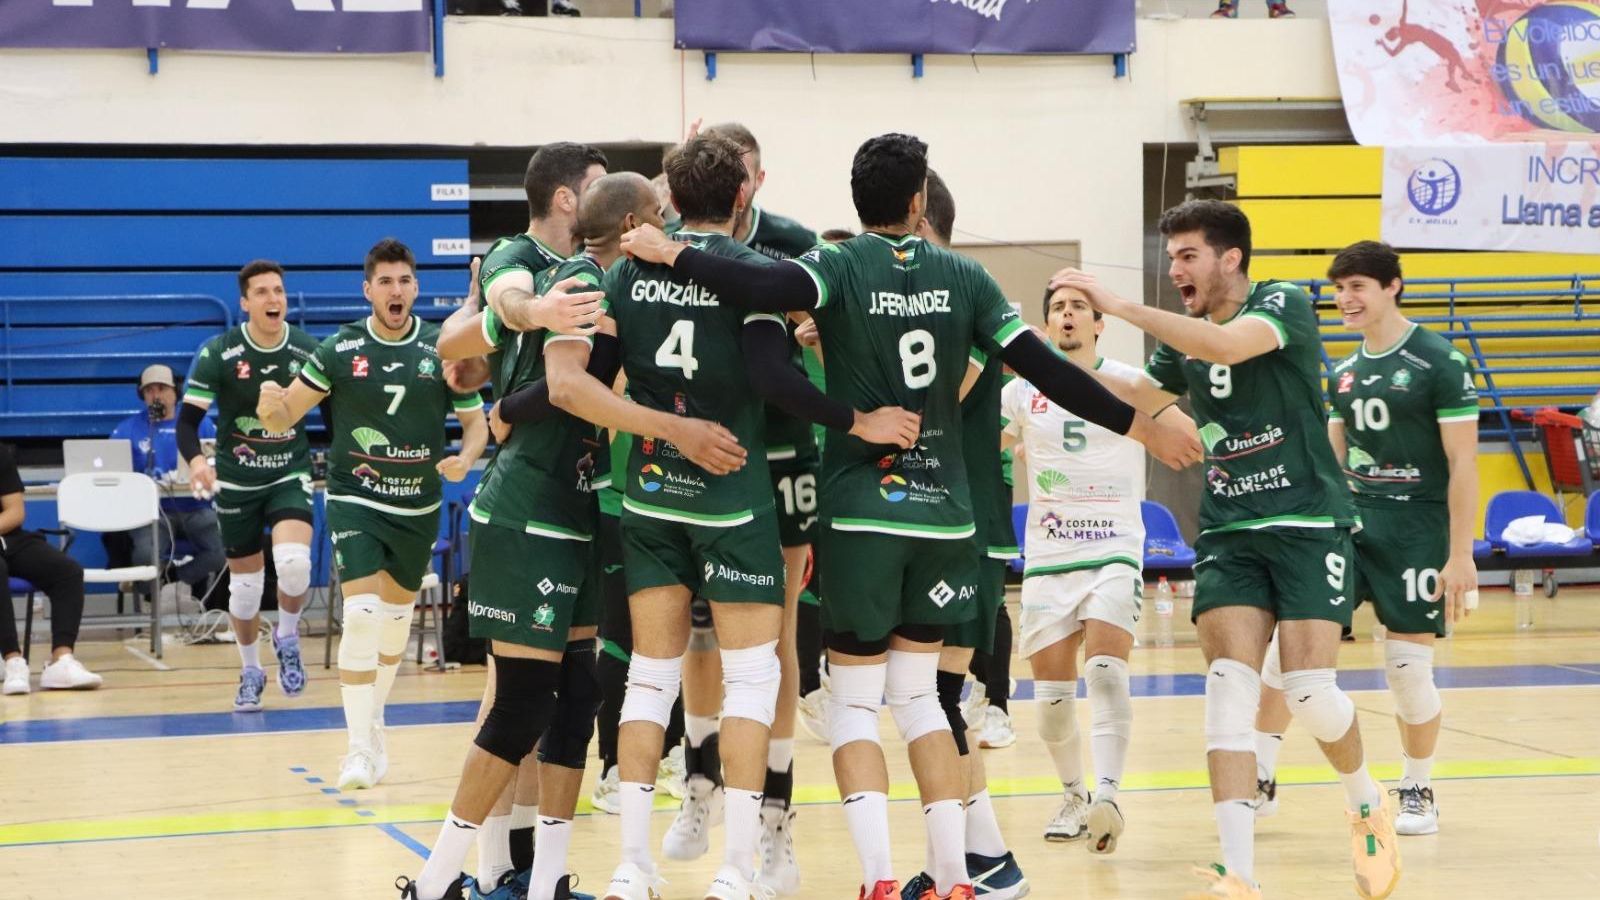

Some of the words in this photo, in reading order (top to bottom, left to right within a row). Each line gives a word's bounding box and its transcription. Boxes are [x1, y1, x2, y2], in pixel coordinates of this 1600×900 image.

[1484, 18, 1506, 43] El
[1490, 63, 1522, 81] es
[1528, 63, 1561, 81] un
[1528, 155, 1600, 185] INCR
[1502, 194, 1582, 227] Llama
[655, 319, 698, 380] 4
[898, 328, 937, 390] 8
[1209, 363, 1233, 399] 9
[383, 384, 406, 415] 7
[1350, 397, 1390, 432] 10
[386, 443, 431, 460] Unicaja
[1062, 420, 1088, 453] 5
[1225, 424, 1284, 452] Unicaja
[382, 477, 412, 486] COSTA
[412, 476, 424, 485] DE
[1269, 464, 1286, 479] DE
[372, 483, 422, 496] ALMERÍA
[778, 474, 818, 515] 16
[1066, 519, 1099, 528] COSTA
[1102, 519, 1114, 527] DE
[716, 564, 775, 586] Alposan
[1325, 552, 1346, 591] 9
[1401, 567, 1442, 602] 10
